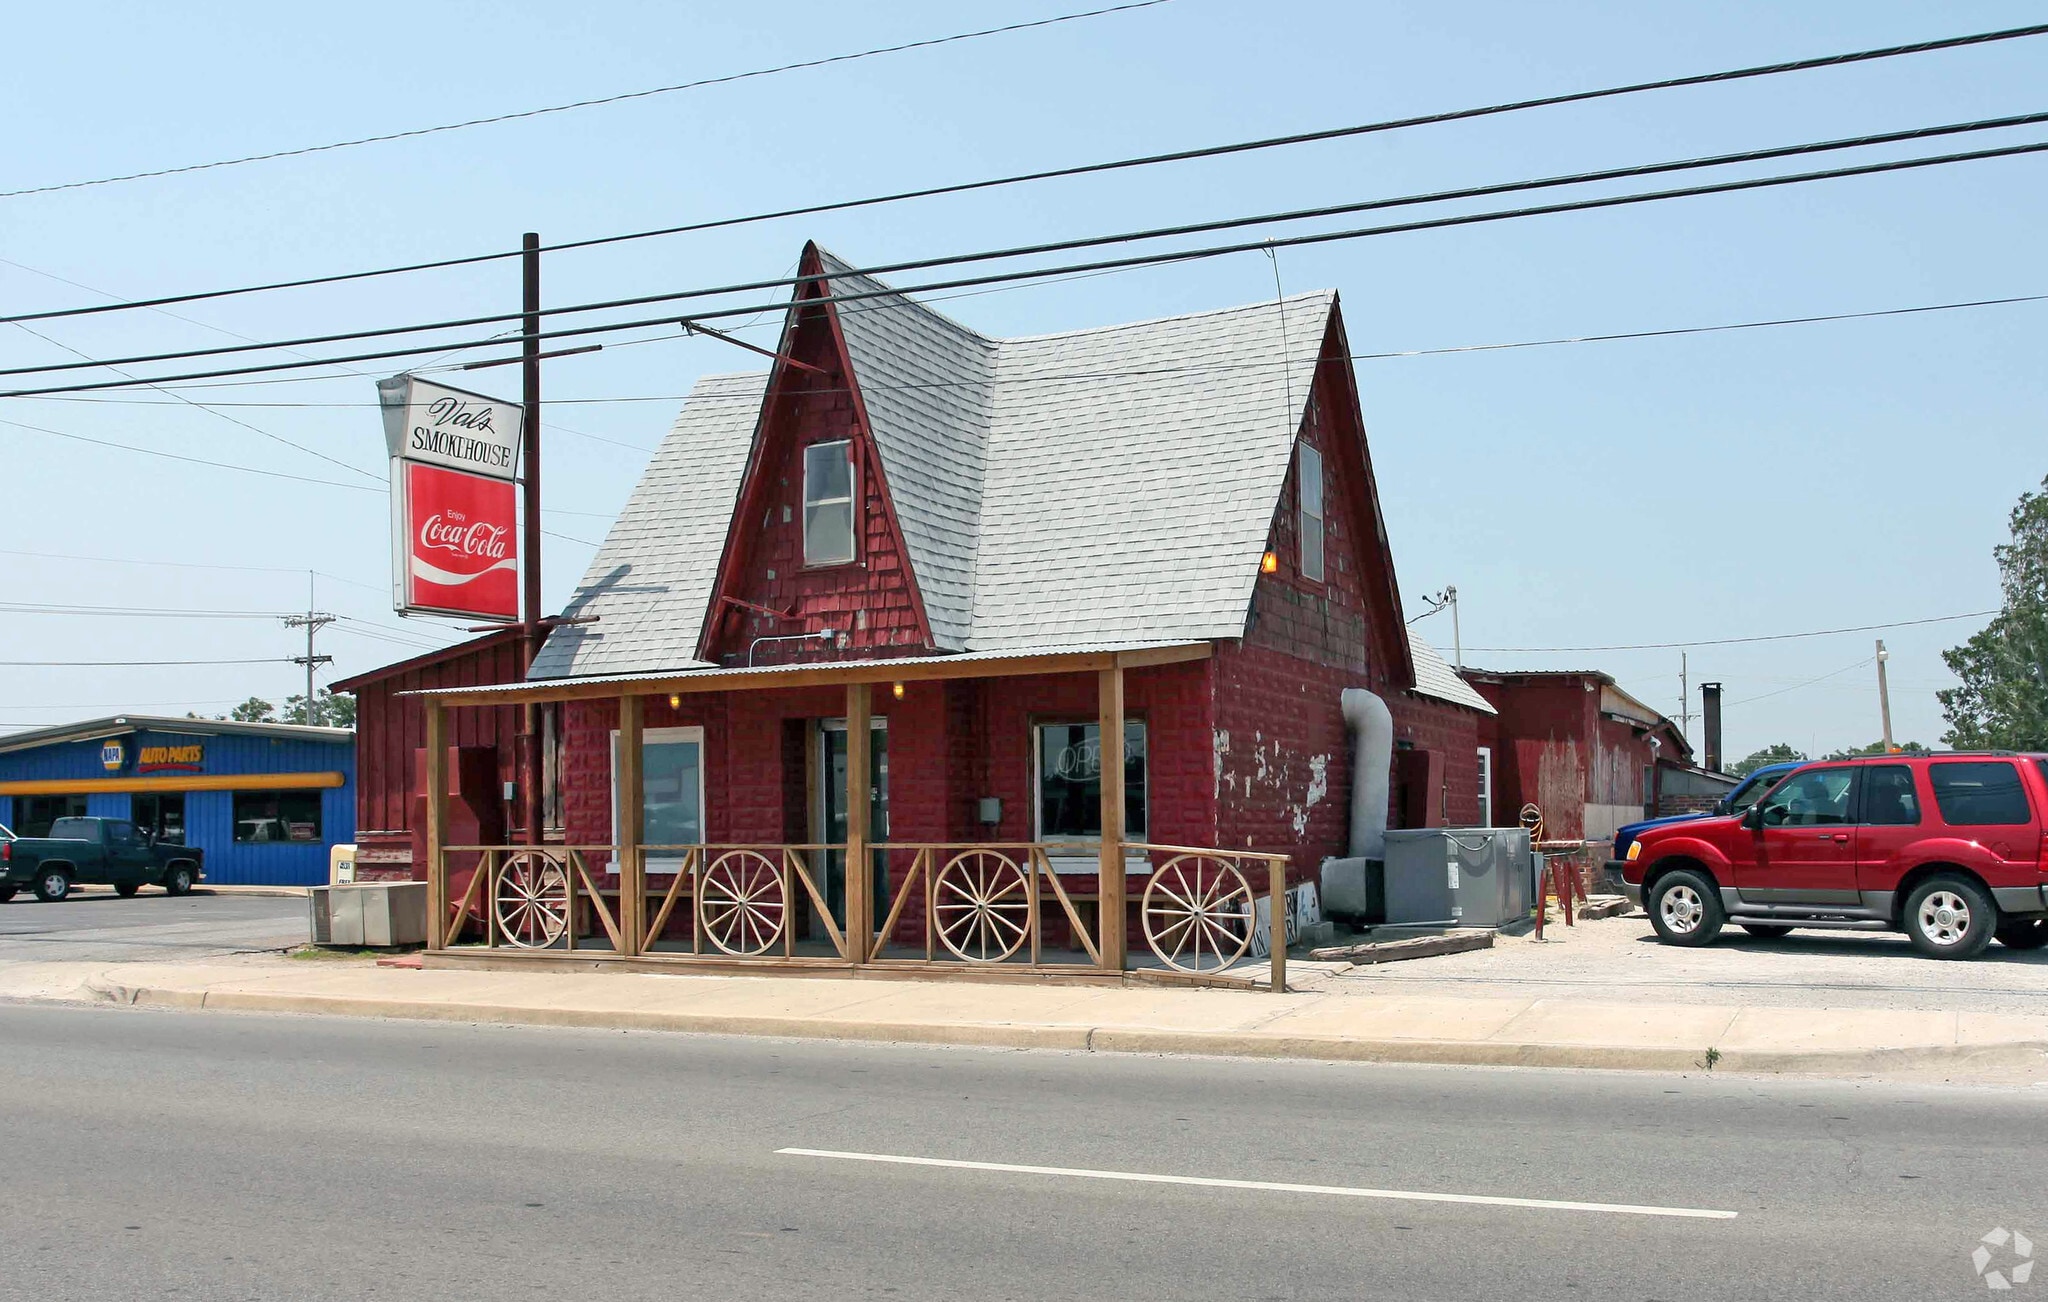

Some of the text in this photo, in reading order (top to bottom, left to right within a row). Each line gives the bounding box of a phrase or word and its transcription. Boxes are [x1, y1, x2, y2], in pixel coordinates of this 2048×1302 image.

[412, 427, 511, 468] SMOKEHOUSE
[447, 509, 466, 522] Enjoy
[421, 514, 508, 559] Coca-Cola
[103, 747, 120, 763] NAPA
[138, 745, 203, 764] AUTO PARTS
[1058, 745, 1102, 774] OPE
